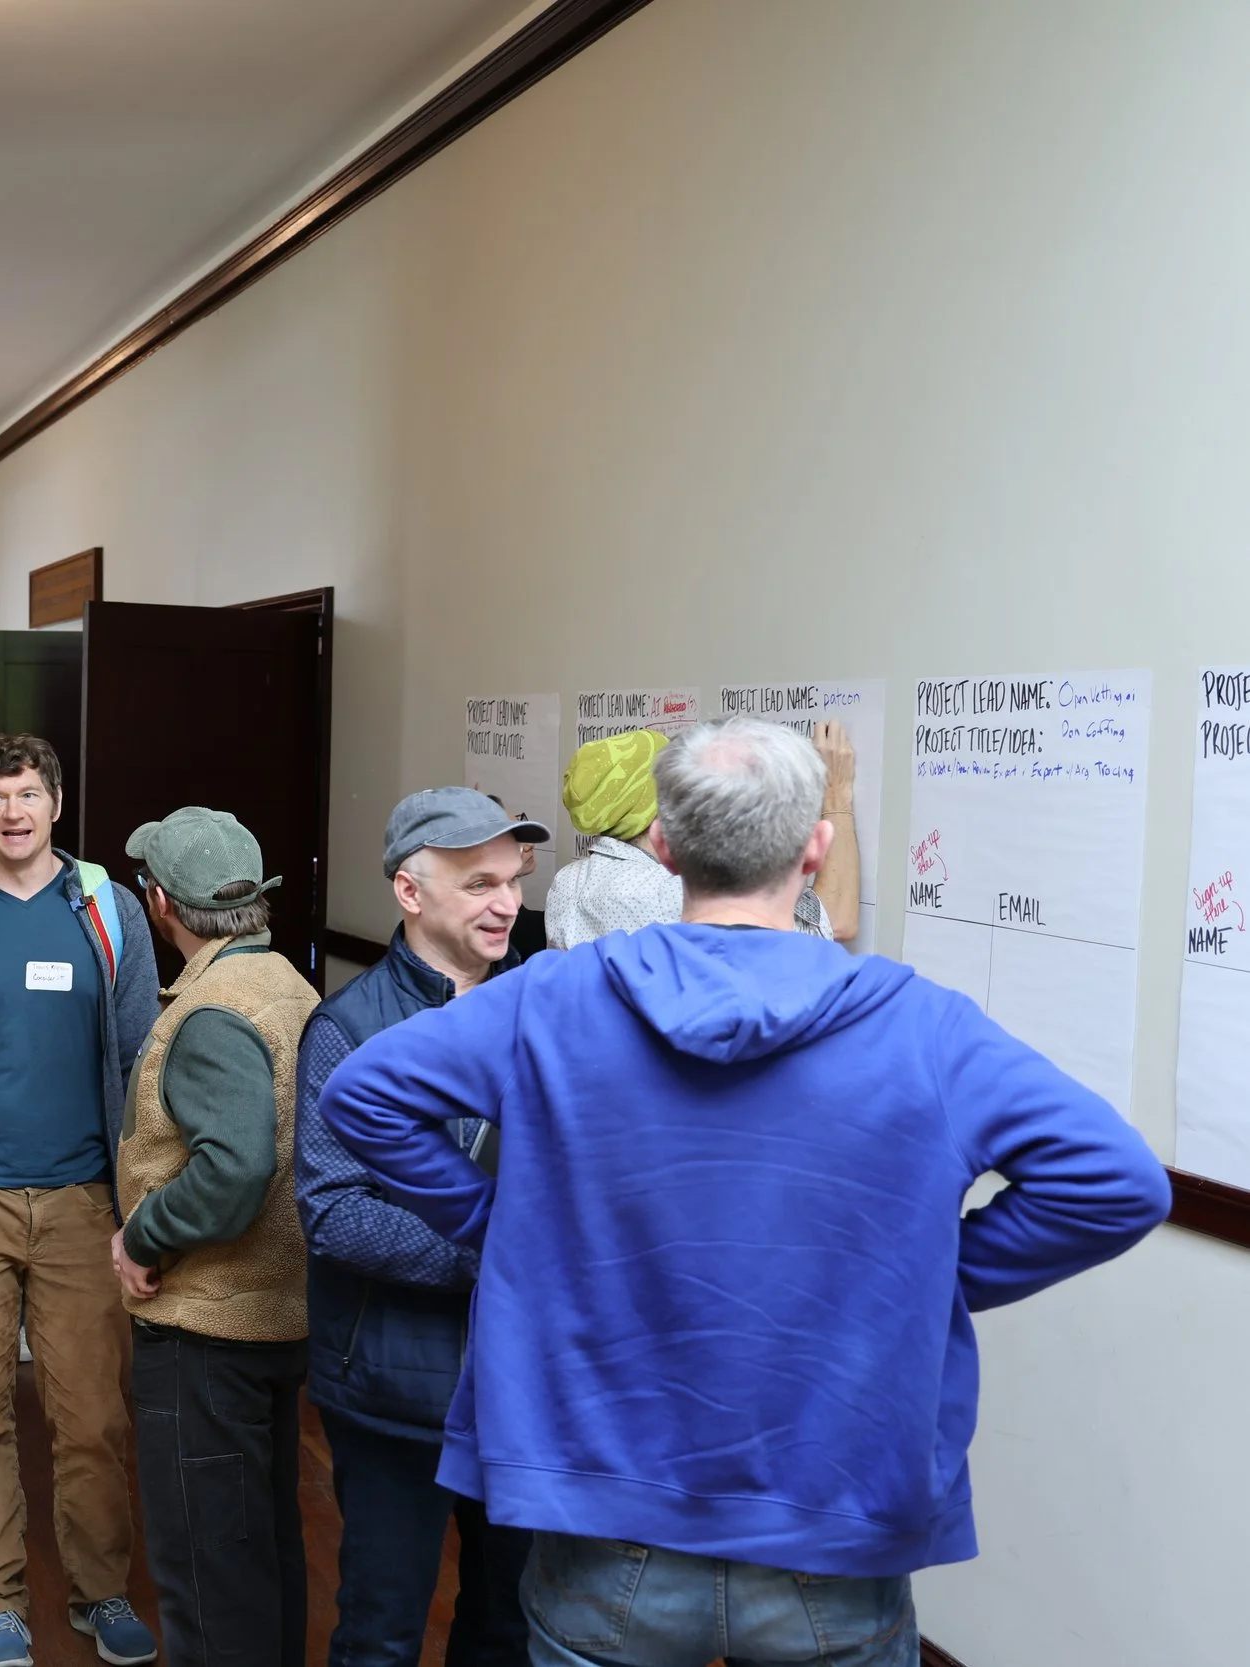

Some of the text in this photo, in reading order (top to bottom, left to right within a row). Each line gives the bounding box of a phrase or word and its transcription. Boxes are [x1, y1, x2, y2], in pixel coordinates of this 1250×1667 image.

[467, 699, 496, 726] PROJECT
[496, 699, 510, 727] LEAD
[578, 692, 605, 719] PROJECT
[607, 693, 624, 717] LEAD
[626, 693, 650, 718] NAME:
[721, 687, 758, 716] PROJECT
[760, 687, 784, 713] LEAD
[786, 686, 819, 711] NAME:
[917, 680, 970, 718] PROJECT
[972, 680, 1006, 715] LEAD
[1009, 680, 1054, 713] NAME:
[467, 729, 492, 755] PROJECT
[915, 724, 1044, 756] PROJECT TITLE/IDEA:
[910, 881, 1047, 926] NAME EMAIL
[1192, 882, 1219, 911] Sign
[1203, 898, 1229, 925] Here
[1188, 926, 1234, 956] NAME
